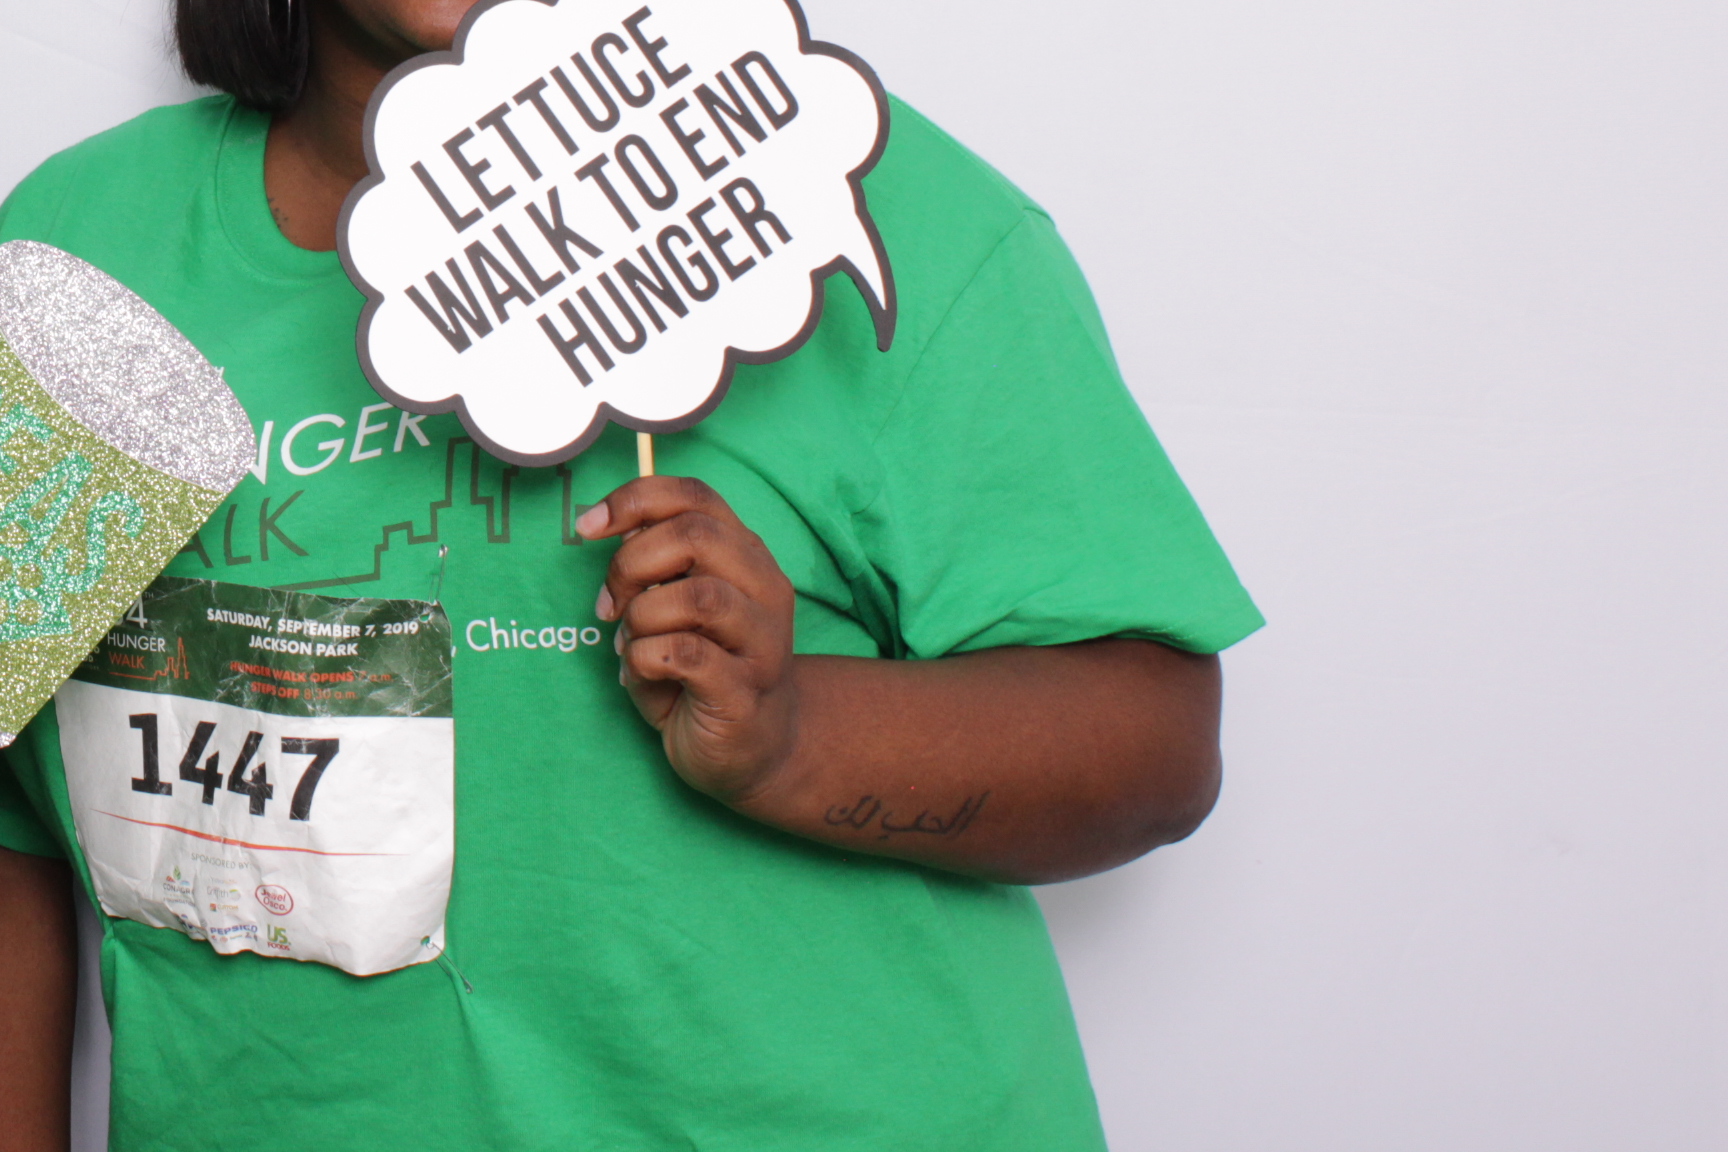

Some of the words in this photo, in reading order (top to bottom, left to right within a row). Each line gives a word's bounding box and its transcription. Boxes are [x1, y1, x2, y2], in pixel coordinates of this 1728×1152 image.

[410, 5, 693, 234] LETTUCE
[403, 186, 604, 354] WALK
[573, 134, 679, 234] TO
[658, 51, 799, 182] END
[536, 177, 793, 388] HUNGER
[248, 402, 431, 486] NGER
[177, 490, 310, 569] ALK
[206, 607, 273, 633] SATURDAY,
[277, 617, 361, 639] SEPTEMBER
[363, 624, 377, 638] 7,
[382, 621, 420, 636] 2019
[465, 617, 601, 653] Chicago
[107, 632, 166, 653] HUNGER
[248, 635, 312, 656] JACKSON
[315, 642, 359, 657] PARK
[108, 651, 146, 669] WALK
[229, 661, 271, 677] HUNGER
[272, 668, 307, 683] WALK
[309, 671, 355, 683] OPENS
[250, 681, 277, 696] STEPS
[278, 687, 300, 699] OFF
[128, 712, 340, 822] 1447
[191, 852, 236, 869] SPONSORED
[210, 924, 258, 936] PEPSICO
